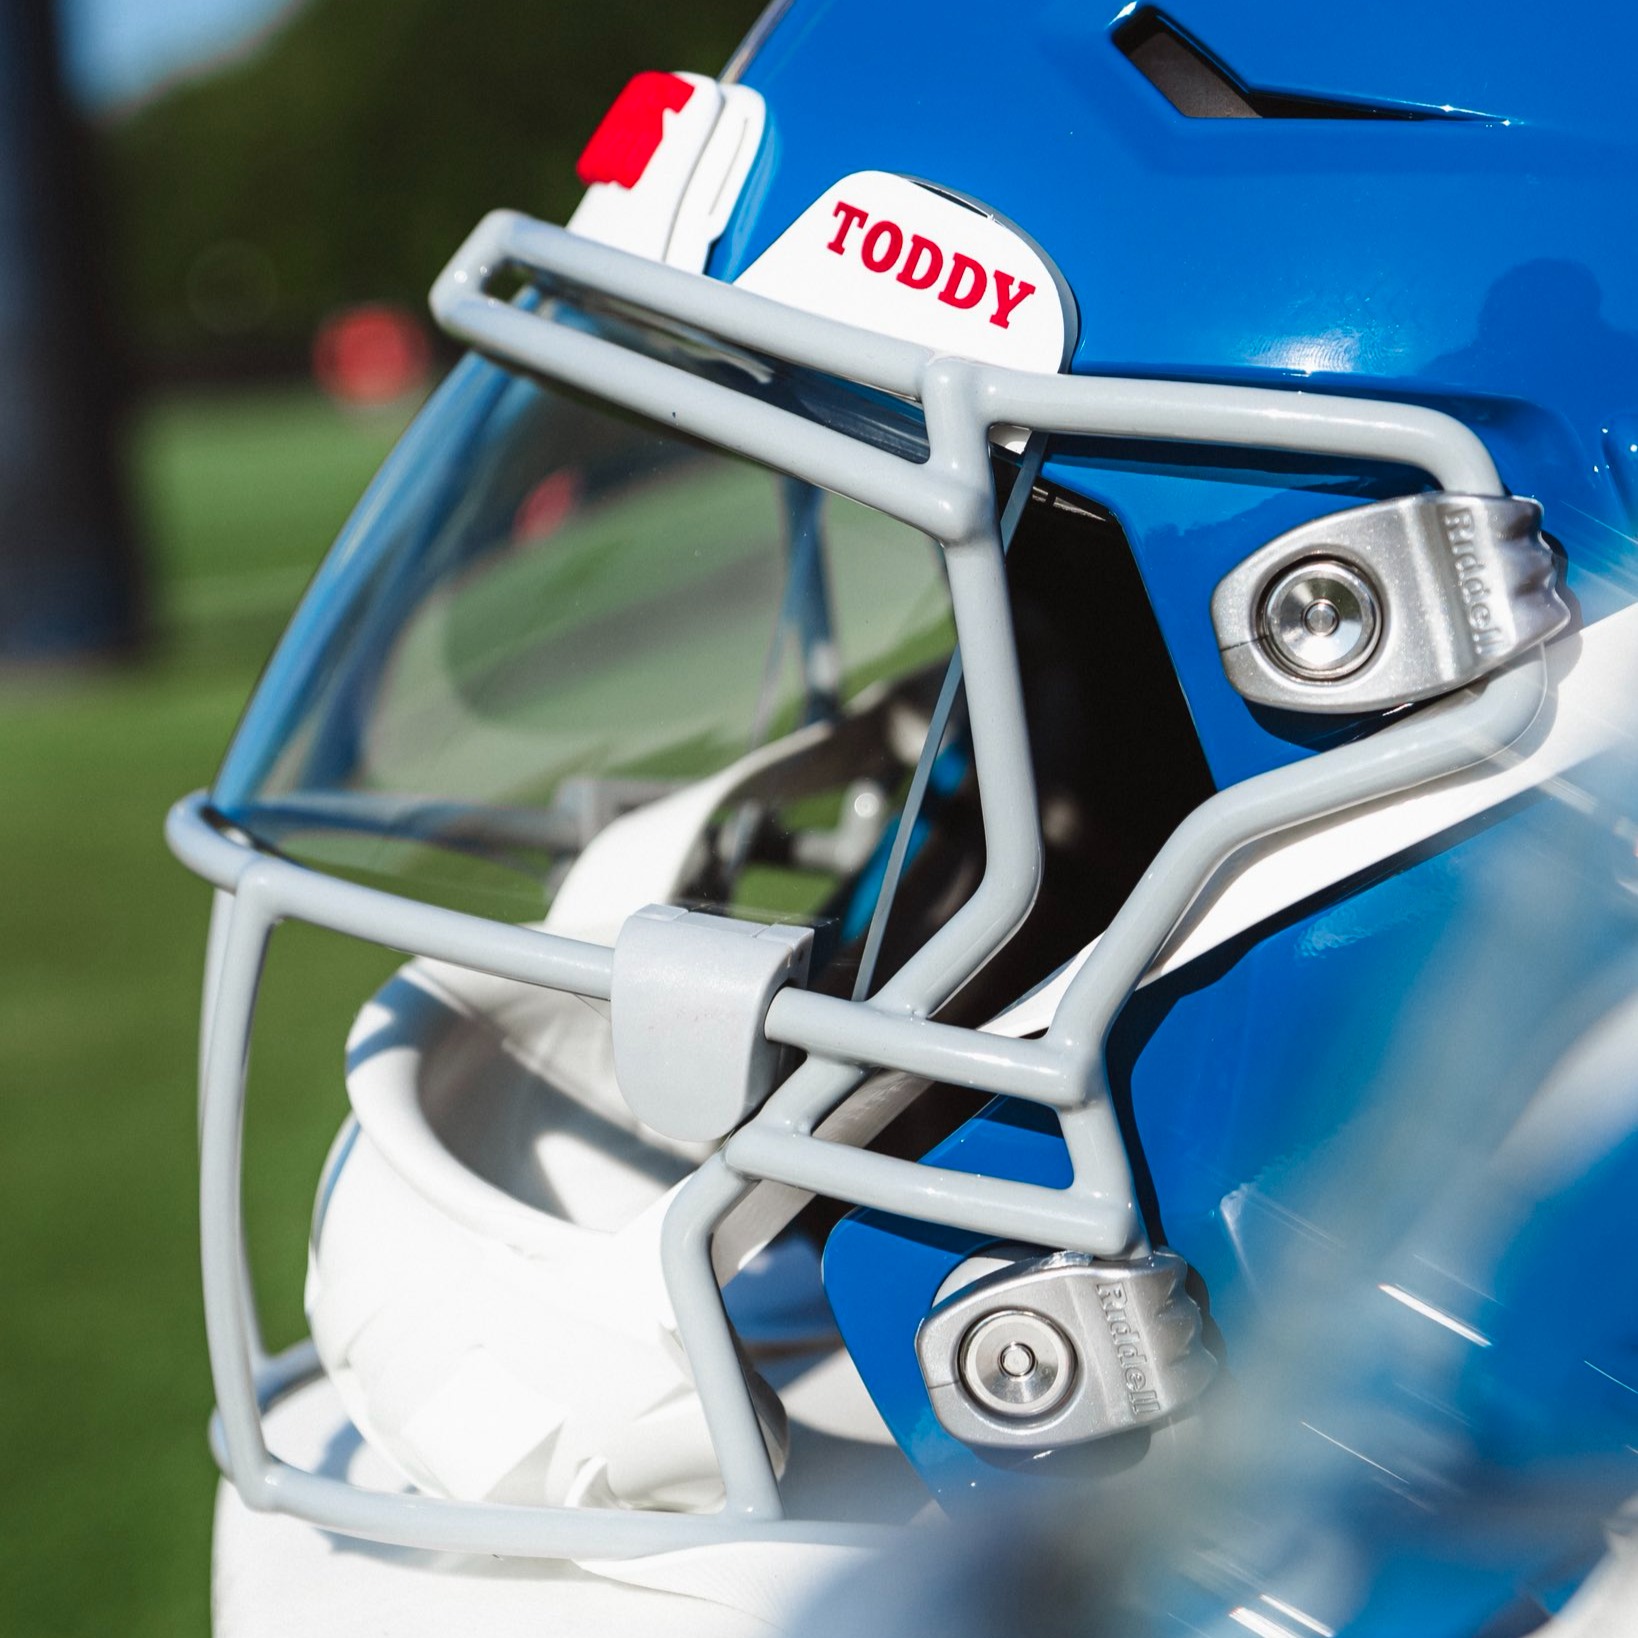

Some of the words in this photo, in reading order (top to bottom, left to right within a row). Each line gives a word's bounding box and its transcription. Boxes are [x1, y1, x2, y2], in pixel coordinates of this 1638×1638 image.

[827, 201, 1036, 329] TODDY
[1444, 508, 1504, 655] Riddell
[1096, 1282, 1160, 1415] Riddell
